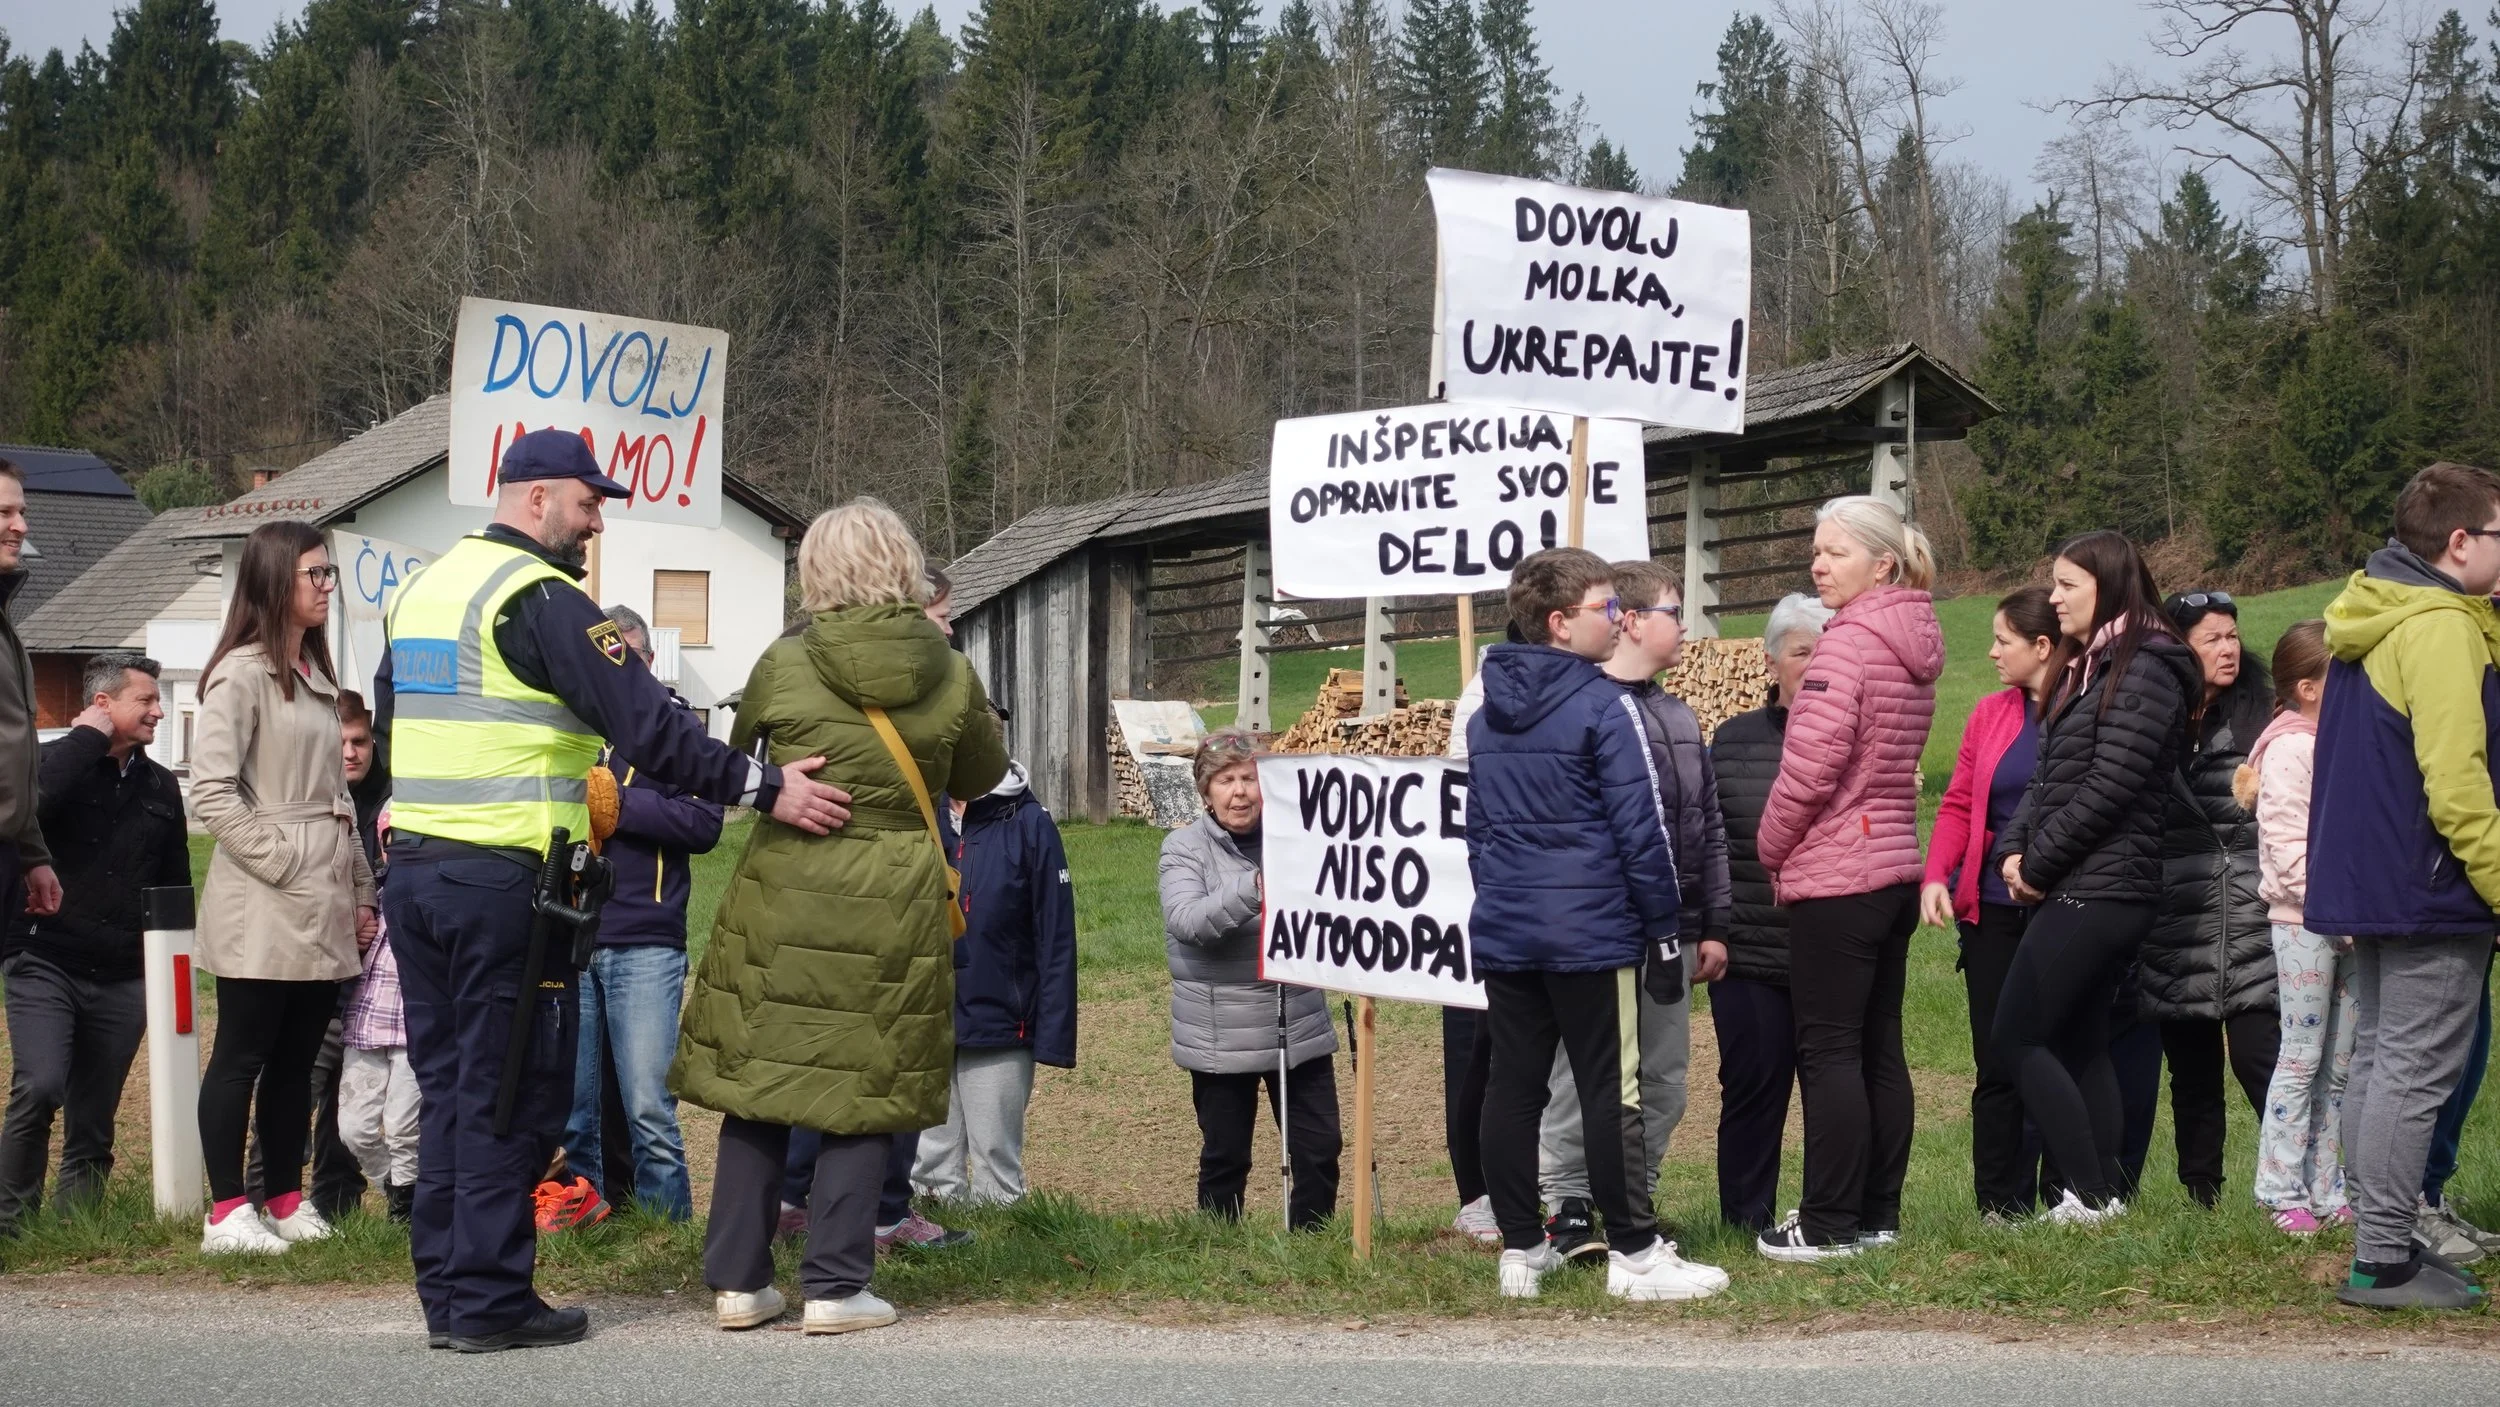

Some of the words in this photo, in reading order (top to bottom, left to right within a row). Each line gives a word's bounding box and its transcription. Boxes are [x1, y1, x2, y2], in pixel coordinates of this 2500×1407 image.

[1515, 197, 1678, 259] DOVOLJ
[1524, 260, 1685, 318] MOLKA,
[483, 313, 712, 419] DOVOLJ
[1463, 318, 1744, 401] UKREPAJTE!
[487, 415, 706, 510] IMO!
[1290, 473, 1459, 523] OPRAVITE
[1297, 767, 1468, 840] VODICE
[1315, 843, 1431, 909] NISO
[1267, 909, 1485, 984] AVTOODPA
